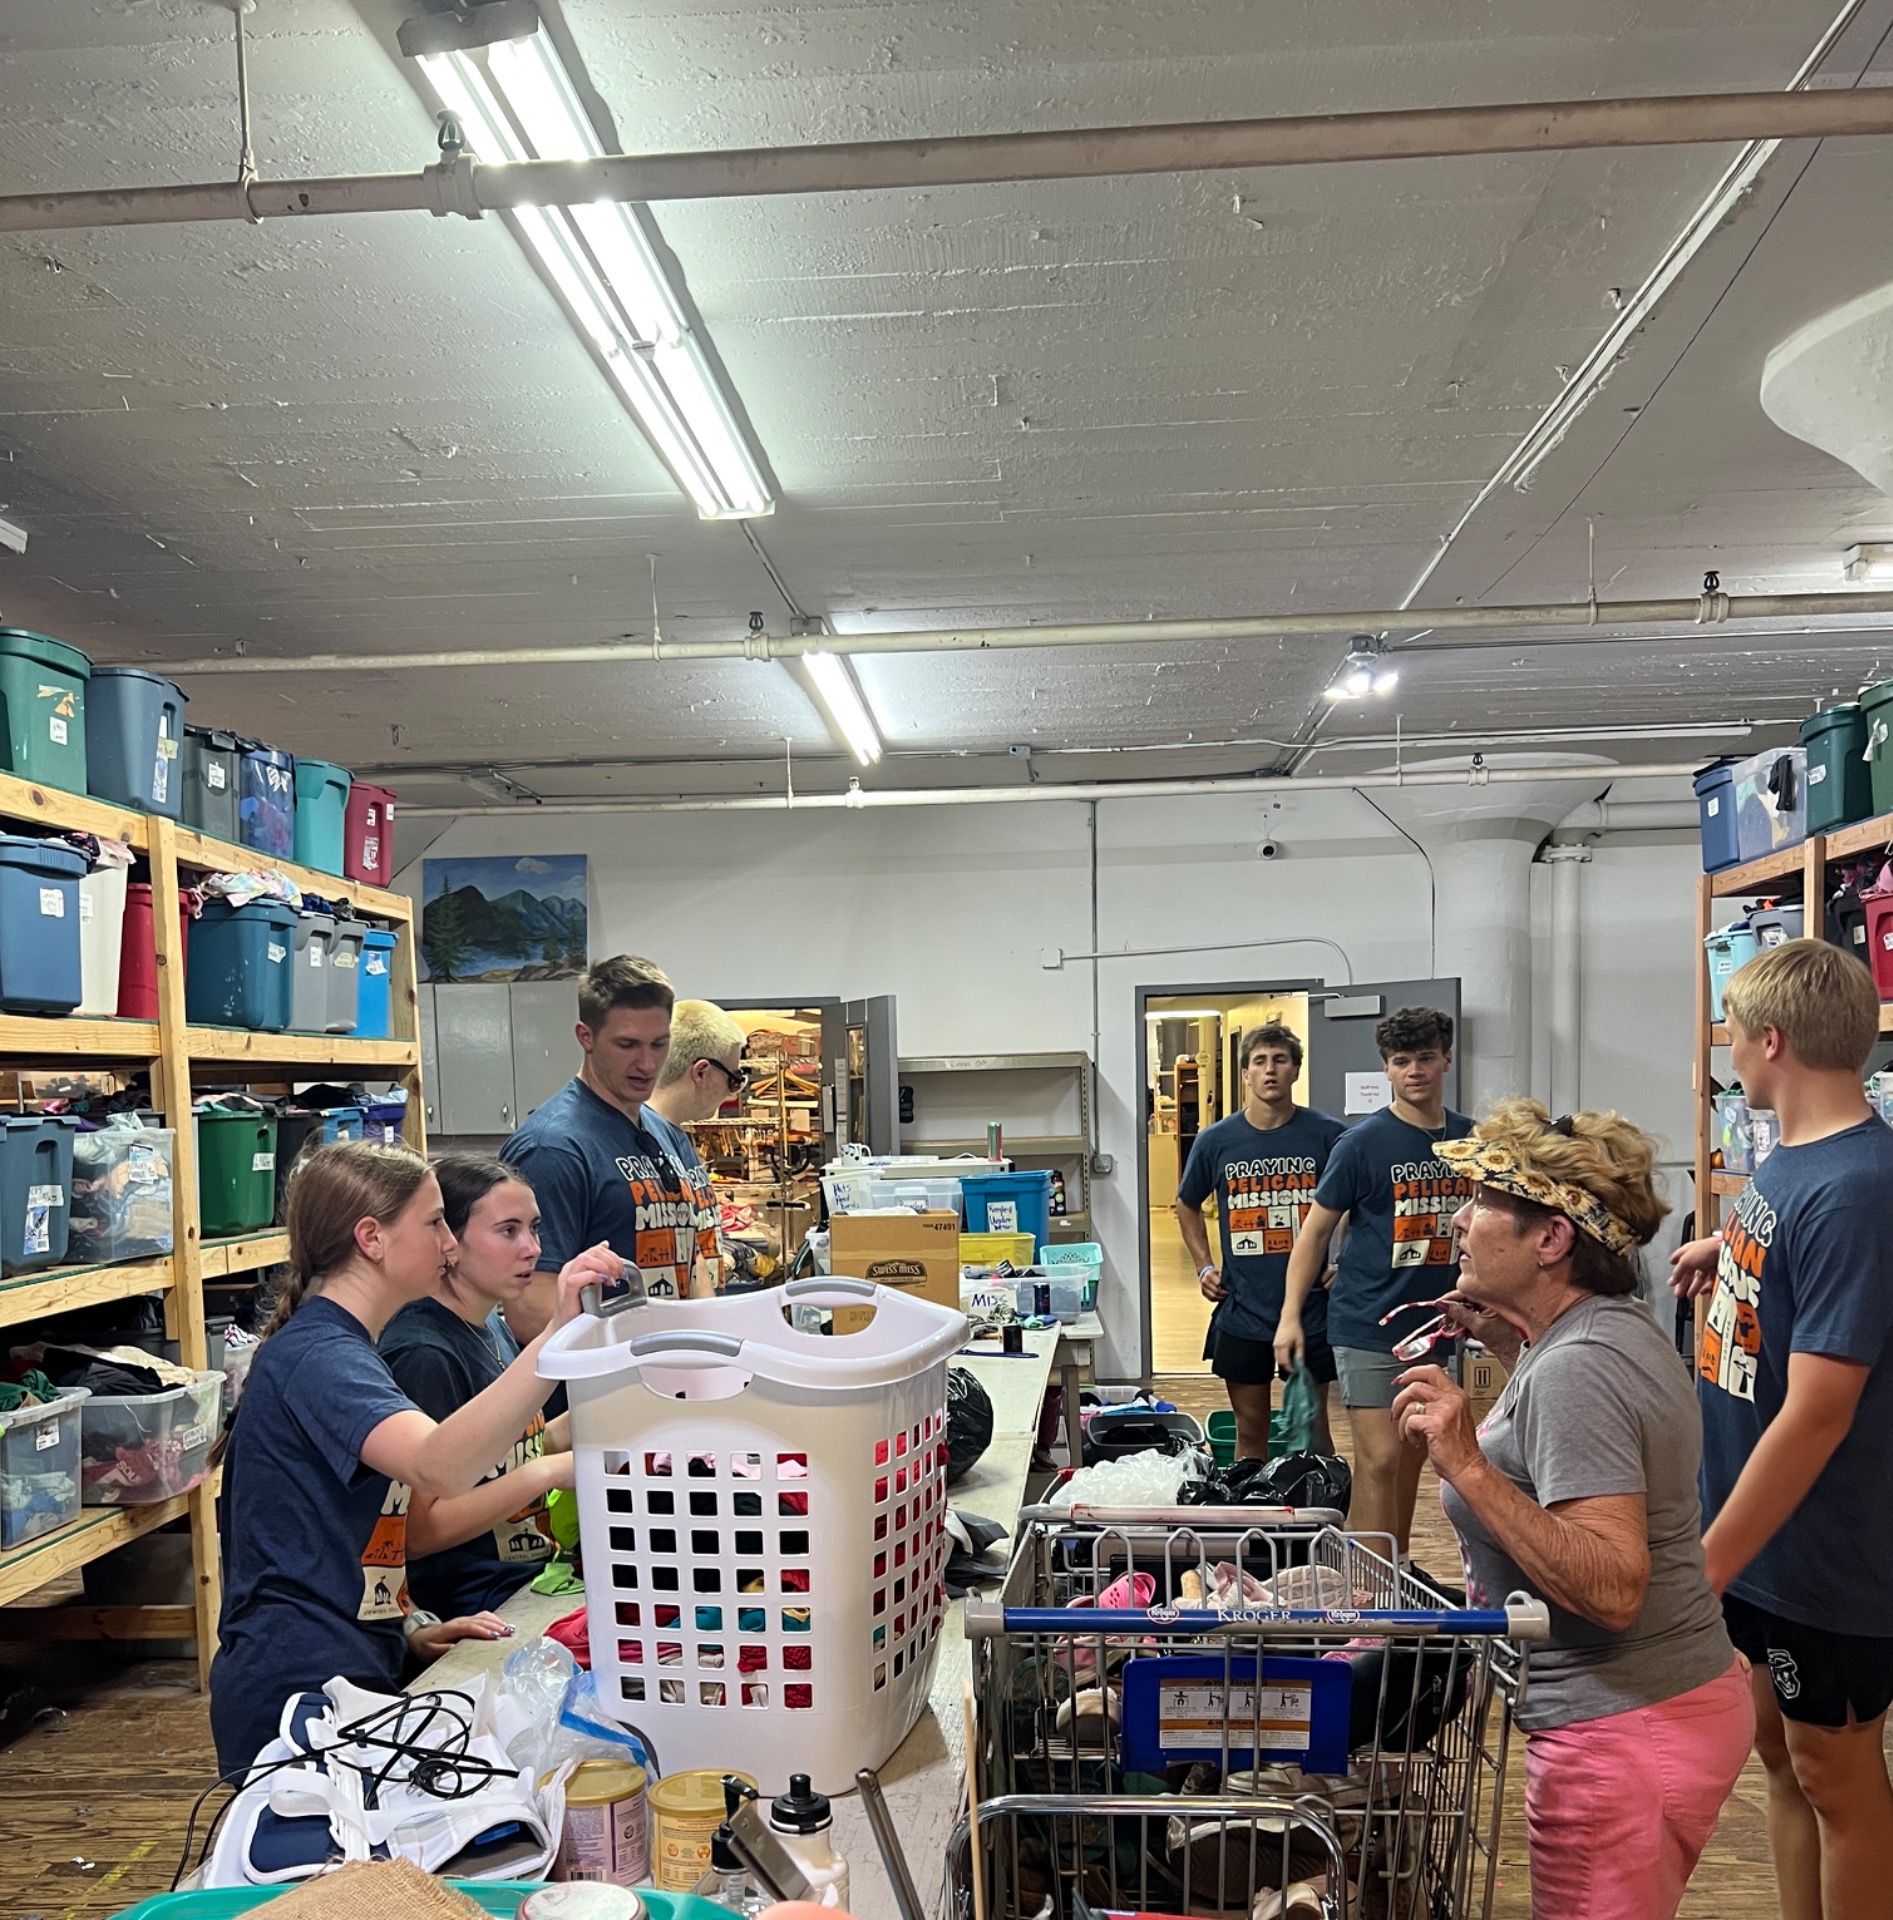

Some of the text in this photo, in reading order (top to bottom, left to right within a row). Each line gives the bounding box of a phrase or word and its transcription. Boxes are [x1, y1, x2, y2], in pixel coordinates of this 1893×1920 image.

[1225, 1157, 1316, 1180] PRAYING
[1391, 1161, 1462, 1184] PRAYI
[1227, 1173, 1317, 1195] PELICAN
[1227, 1188, 1317, 1210] MISSIONS
[1217, 1608, 1292, 1623] KROGER
